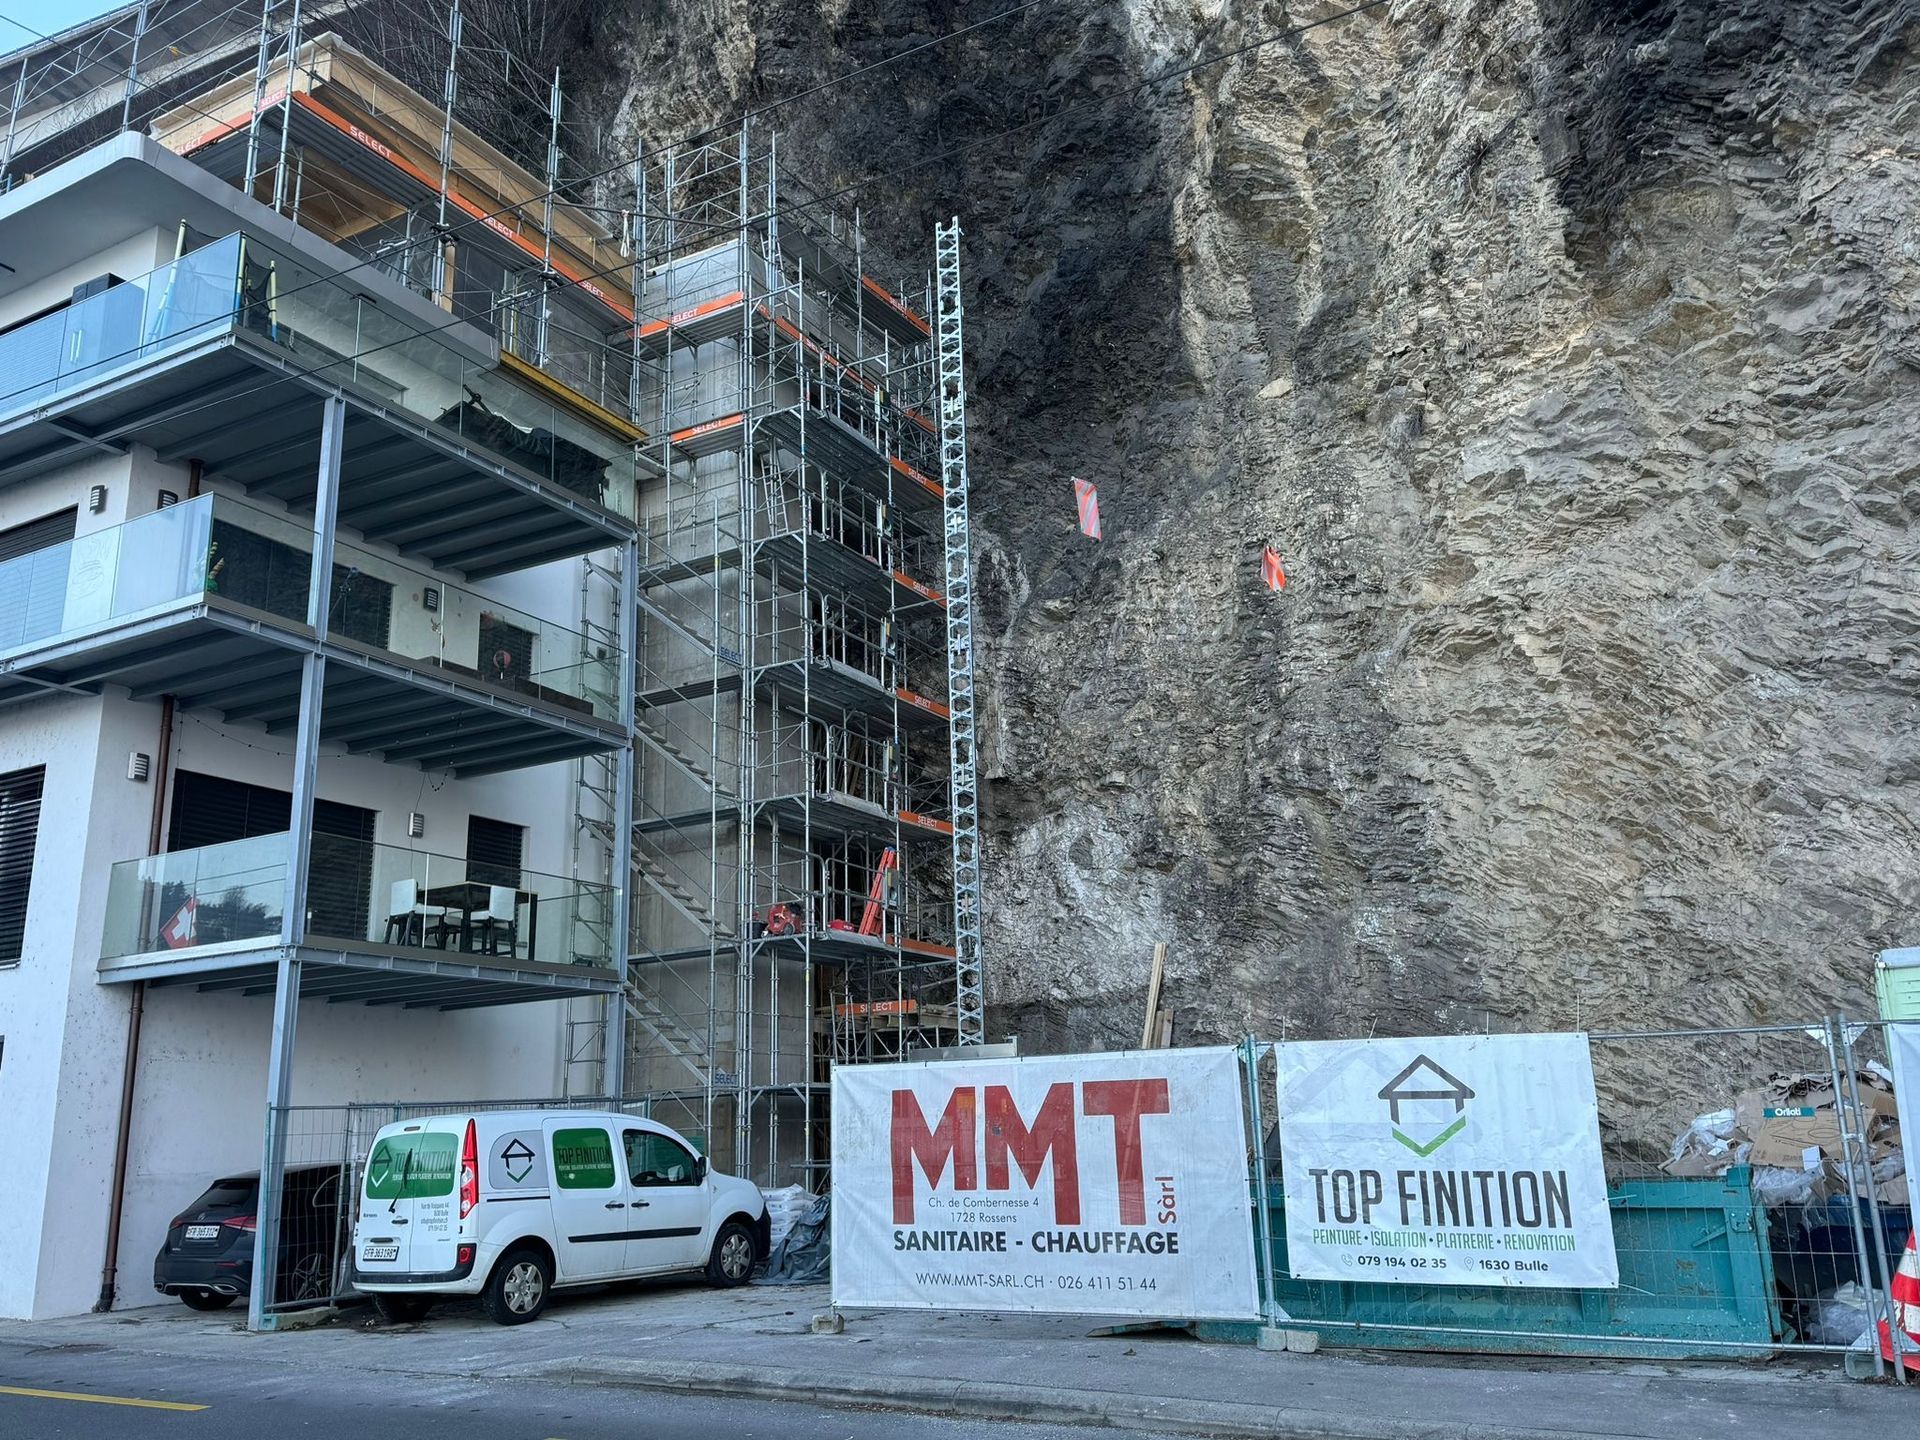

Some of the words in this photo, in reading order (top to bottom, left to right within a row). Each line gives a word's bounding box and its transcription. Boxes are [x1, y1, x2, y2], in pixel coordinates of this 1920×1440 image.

[350, 125, 392, 159] SELECT
[483, 213, 514, 239] SELECT
[913, 581, 930, 596] SELECT
[914, 695, 932, 709] SELECT
[917, 815, 937, 828] SELECT
[891, 1078, 1170, 1225] MMT
[928, 1197, 945, 1208] Ch.
[948, 1197, 960, 1208] de
[963, 1197, 1029, 1208] Combernesse
[1032, 1197, 1039, 1208] 4
[1154, 1176, 1177, 1224] Sàrl
[1308, 1168, 1383, 1224] TOP
[1397, 1170, 1572, 1229] FINITION
[950, 1212, 976, 1223] 1728
[979, 1212, 1017, 1223] Rossens
[893, 1230, 1007, 1252] SANITAIRE
[1031, 1231, 1179, 1255] CHAUFFAGE
[1313, 1228, 1362, 1246] PEINTURE
[1370, 1230, 1427, 1248] ISOLATION
[1436, 1232, 1495, 1250] PLATRERIE
[1503, 1233, 1576, 1252] RENOVATION
[1357, 1255, 1381, 1266] 079
[1384, 1256, 1406, 1268] 194
[1410, 1257, 1427, 1268] 02
[1431, 1258, 1447, 1269] 35
[1479, 1260, 1510, 1271] 1630
[1514, 1260, 1549, 1272] Bulle
[916, 1272, 1044, 1289] WWW.MMT-SARL.CH
[1057, 1275, 1083, 1290] 026
[1087, 1276, 1111, 1290] 411
[1118, 1276, 1133, 1291] 51
[1139, 1277, 1157, 1291] 44
